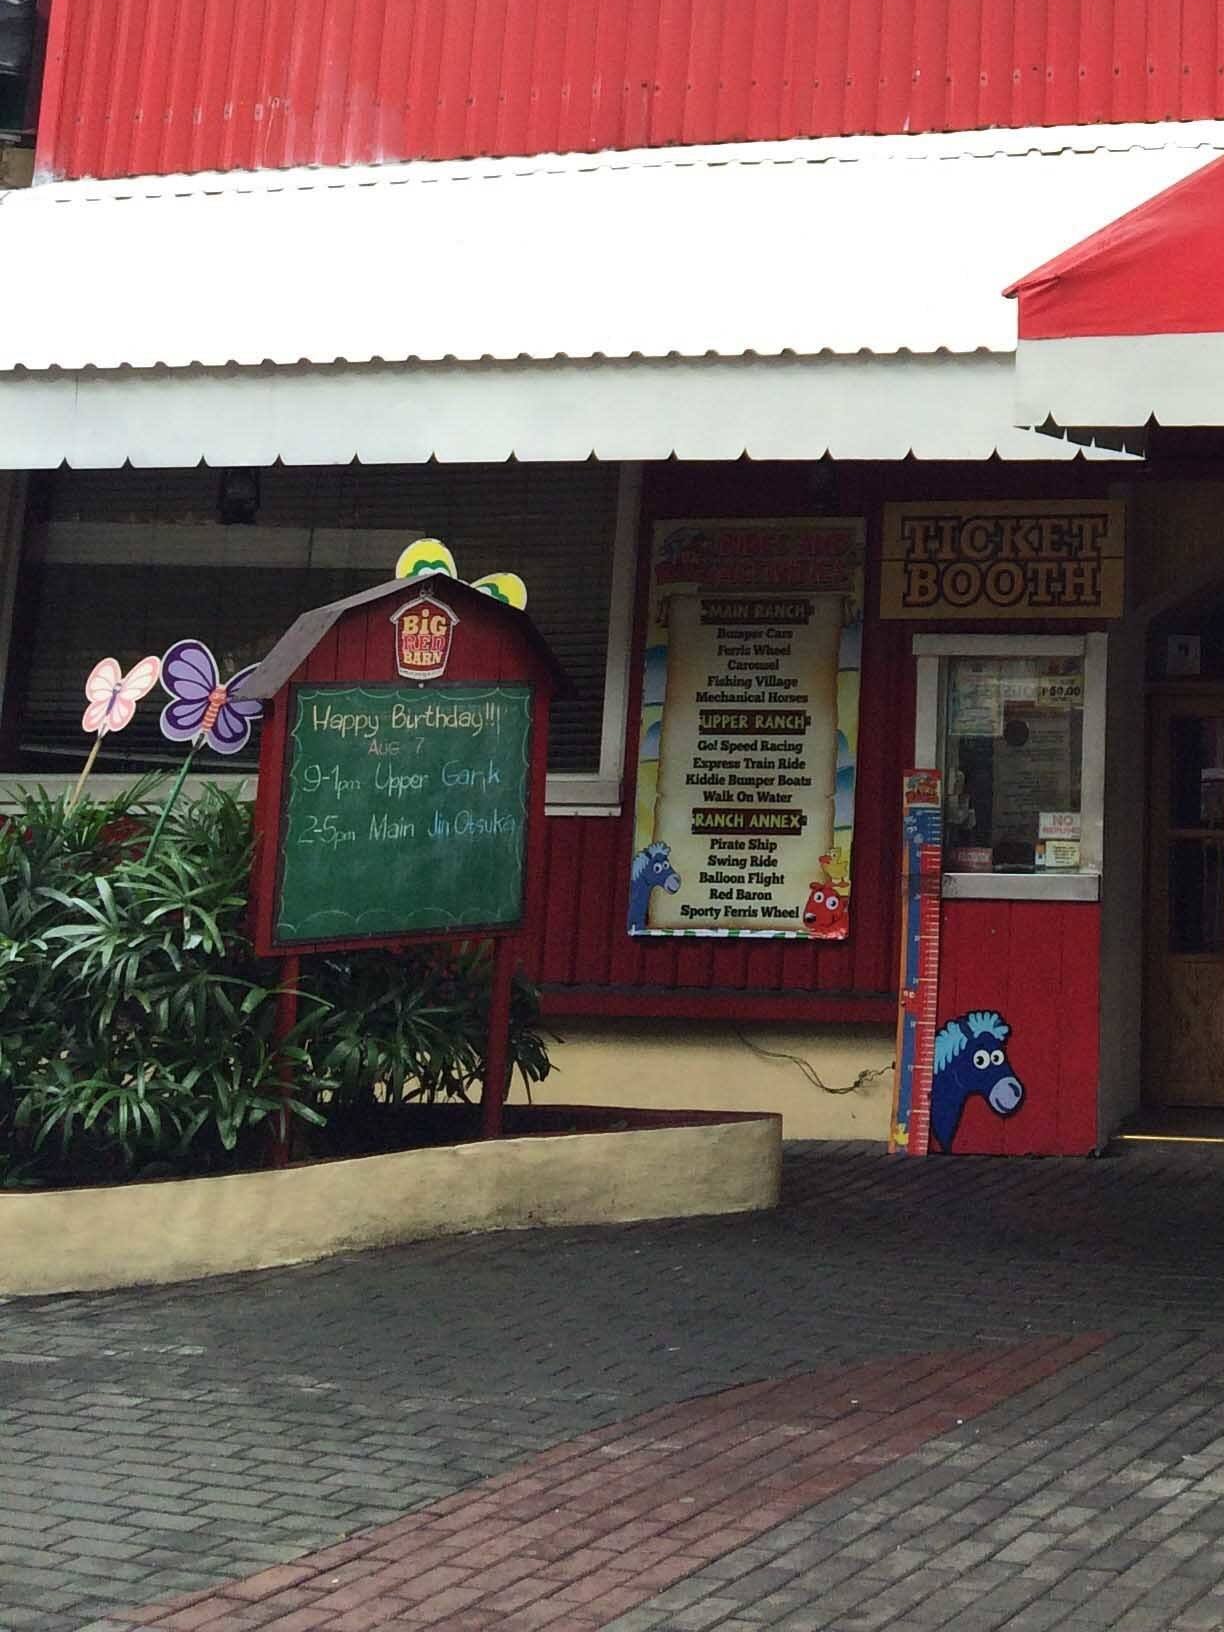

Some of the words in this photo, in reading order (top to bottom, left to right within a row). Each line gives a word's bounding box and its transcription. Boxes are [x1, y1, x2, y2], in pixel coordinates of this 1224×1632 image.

[902, 514, 1109, 560] TICKET
[903, 560, 1102, 607] BOOTH
[711, 604, 749, 618] MAIN
[754, 603, 804, 618] RANCH
[717, 628, 762, 641] Bumper
[717, 645, 750, 656] Ferris
[753, 645, 791, 656] Wheel
[403, 651, 443, 666] BARN
[707, 676, 752, 689] Fishing
[755, 676, 798, 689] Village
[695, 692, 765, 703] Mechanical
[768, 692, 809, 704] Horses
[312, 704, 380, 738] Happy
[702, 715, 749, 729] UPPER
[754, 715, 805, 729] RANCH
[415, 736, 426, 755] 7
[697, 740, 718, 751] Go!
[720, 740, 757, 754] Speed
[760, 740, 803, 754] Racing
[693, 758, 740, 771] Express
[743, 758, 775, 769] Train
[778, 758, 806, 769] Ride
[374, 761, 431, 798] Upper
[685, 774, 726, 785] Kiddie
[728, 774, 775, 788] Bumper
[777, 775, 812, 786] Boats
[703, 791, 734, 802] Walk
[737, 792, 754, 802] On
[758, 791, 793, 803] Water
[694, 813, 744, 828] RANCH
[750, 813, 801, 828] ANNEX
[1052, 815, 1074, 826] NO
[297, 814, 356, 850] 2-5pm
[369, 813, 416, 841] Main
[710, 839, 746, 850] Pirate
[748, 839, 778, 853] Ship
[707, 855, 747, 869] Swing
[749, 856, 778, 867] Ride
[699, 872, 745, 884] Balloon
[748, 873, 785, 887] Flight
[709, 889, 734, 900] Red
[736, 889, 772, 900] Baron
[680, 905, 721, 920] Sporty
[724, 905, 758, 918] Ferris
[761, 906, 800, 918] Wheel
